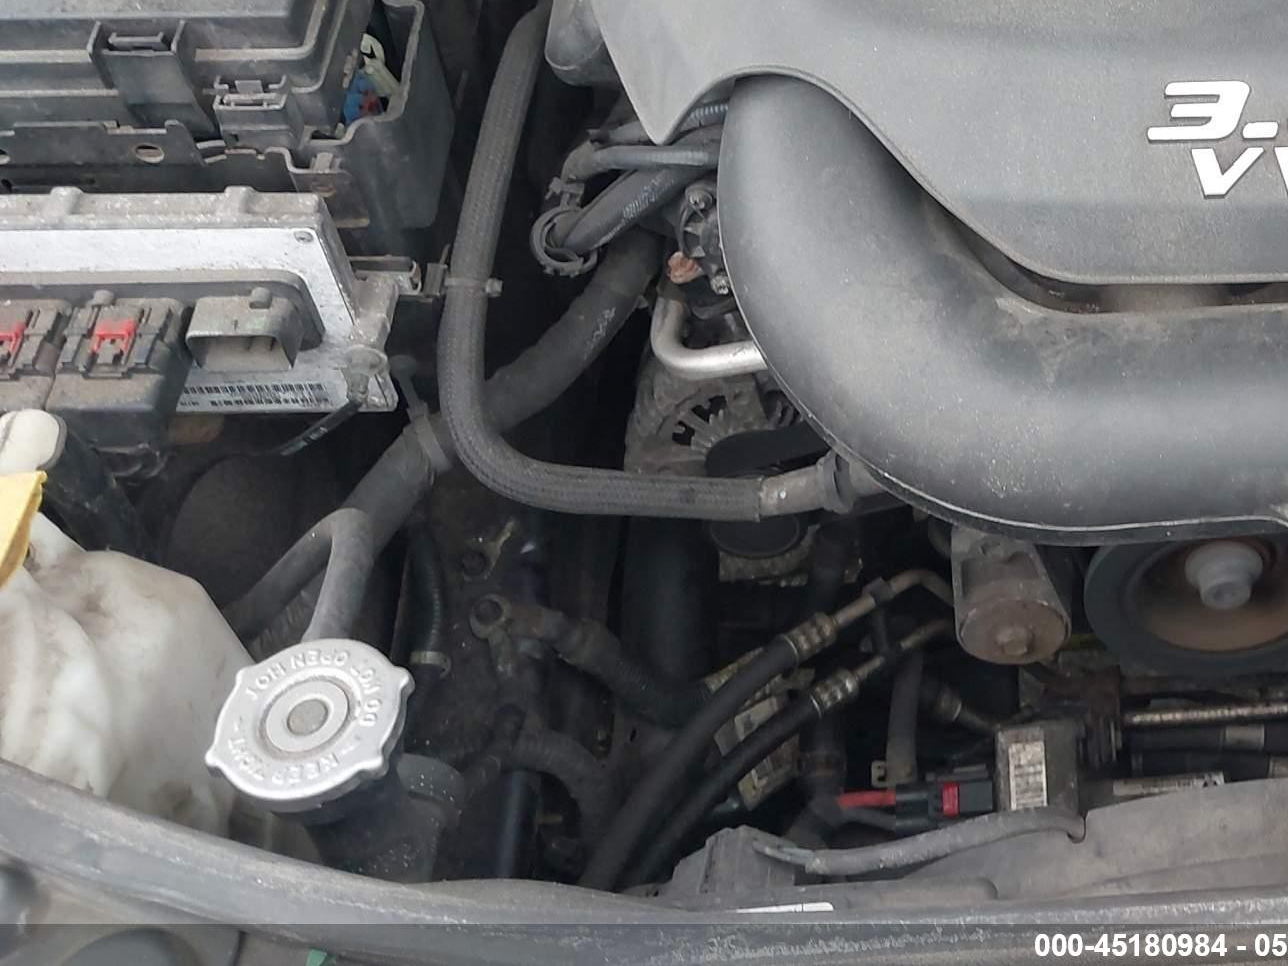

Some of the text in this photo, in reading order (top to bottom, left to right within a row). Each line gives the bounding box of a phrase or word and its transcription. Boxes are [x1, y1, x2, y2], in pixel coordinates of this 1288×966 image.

[290, 649, 350, 669] OPEN
[246, 662, 288, 701] HOT
[359, 698, 383, 727] DO
[272, 753, 340, 785] KEEP
